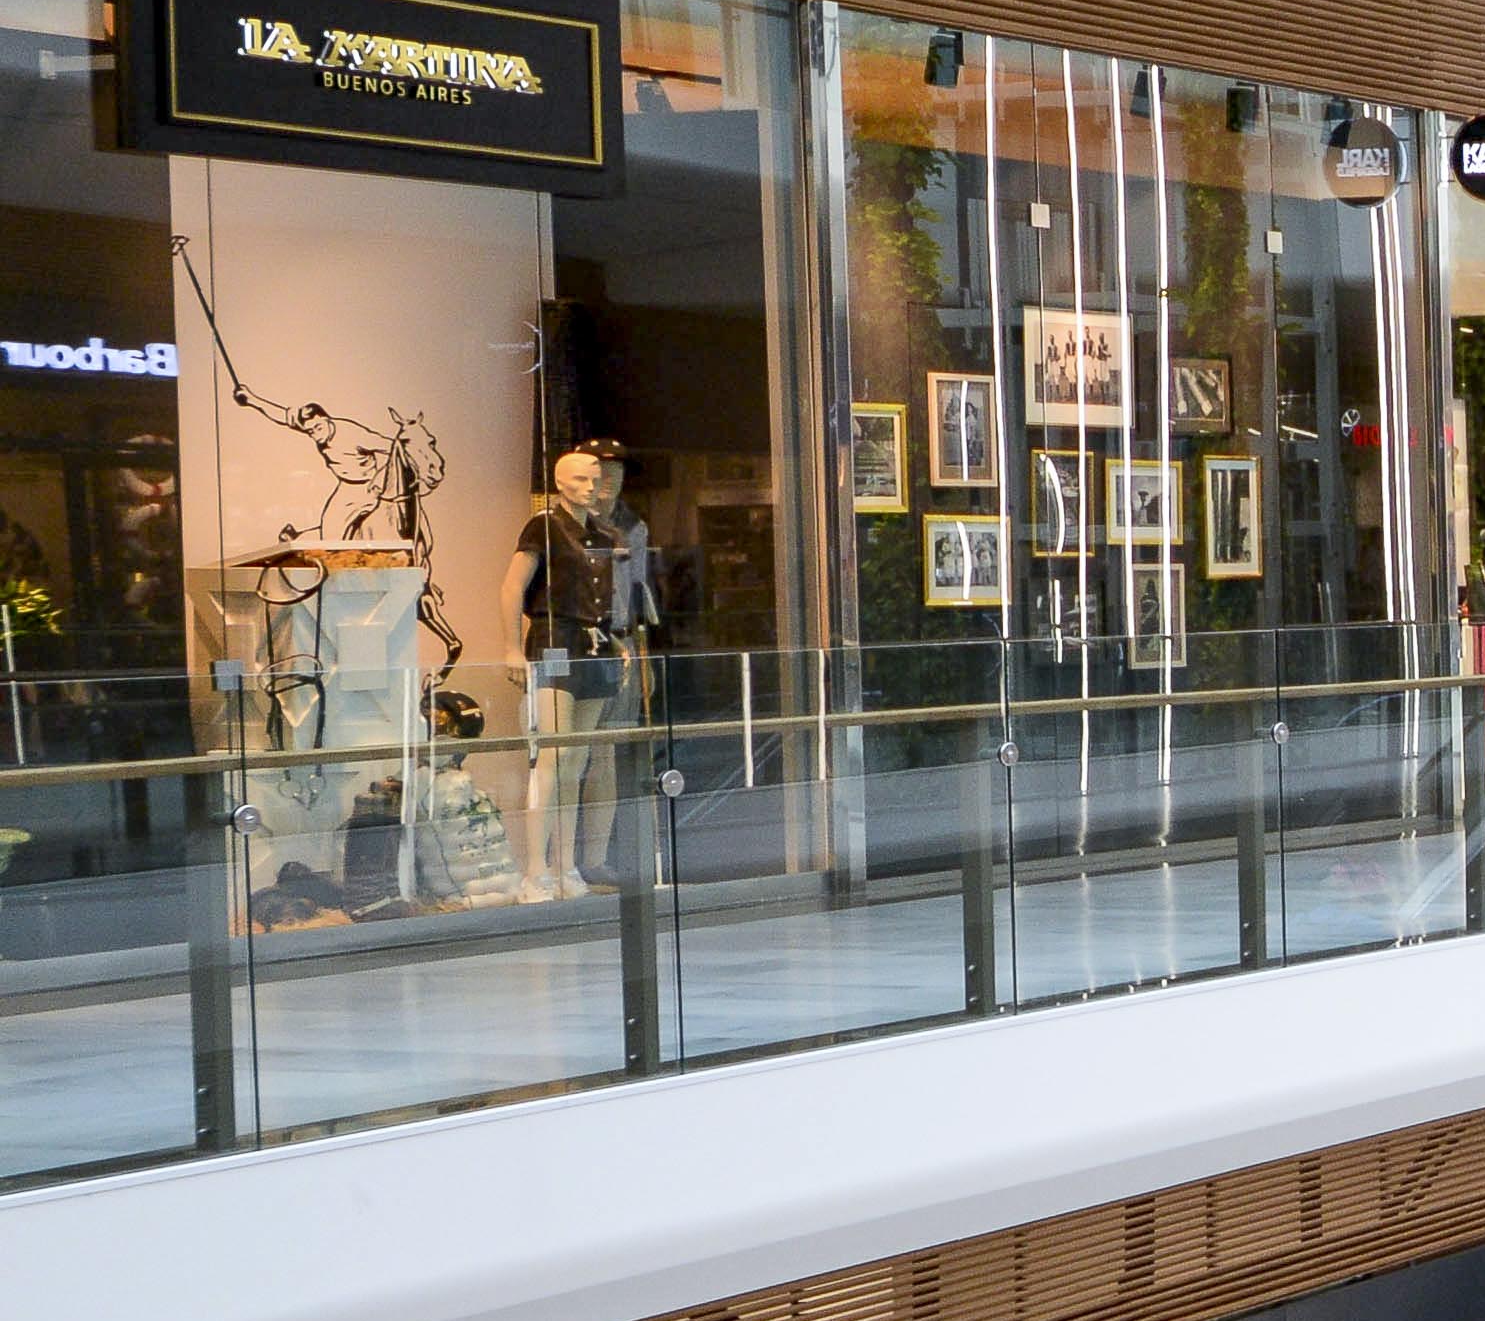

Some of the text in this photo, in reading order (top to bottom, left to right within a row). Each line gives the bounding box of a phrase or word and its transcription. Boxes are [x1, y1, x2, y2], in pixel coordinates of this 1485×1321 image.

[316, 30, 543, 94] MARTINA
[323, 72, 472, 105] BUENOS AIRES
